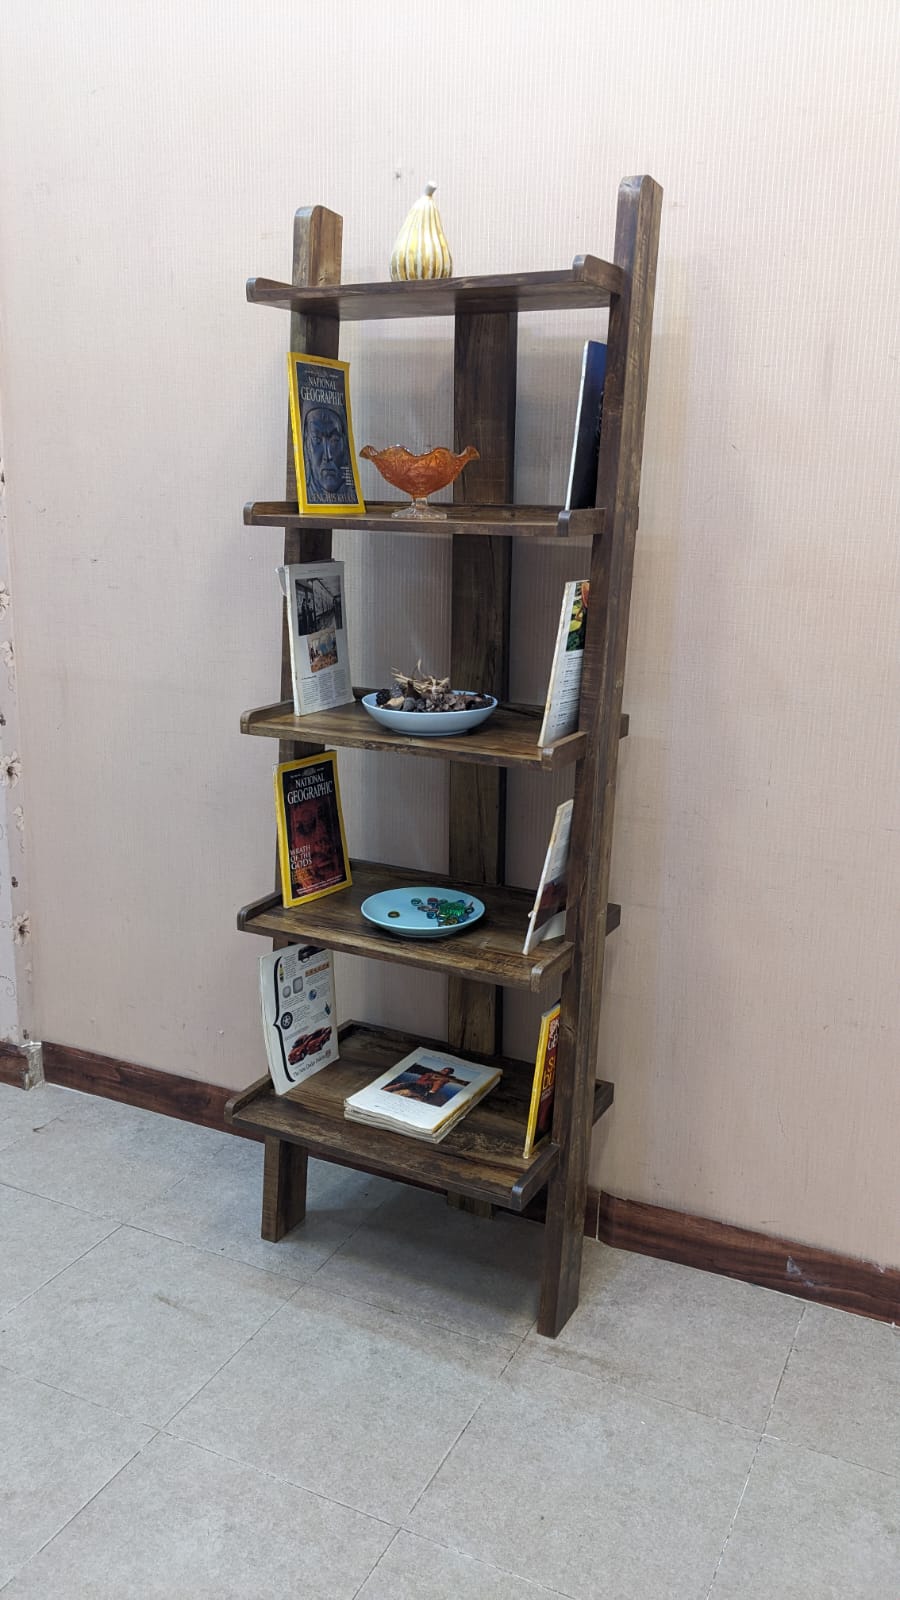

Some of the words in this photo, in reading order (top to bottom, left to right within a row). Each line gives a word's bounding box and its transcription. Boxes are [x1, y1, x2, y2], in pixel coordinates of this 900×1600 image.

[308, 376, 336, 391] NATIONAL
[301, 385, 344, 406] GEOGRAPHIC
[295, 772, 324, 789] NATIONAL
[287, 780, 333, 805] GEOGRAPHIC
[290, 845, 311, 856] WRATH
[300, 852, 311, 860] THE
[291, 858, 313, 870] GODS
